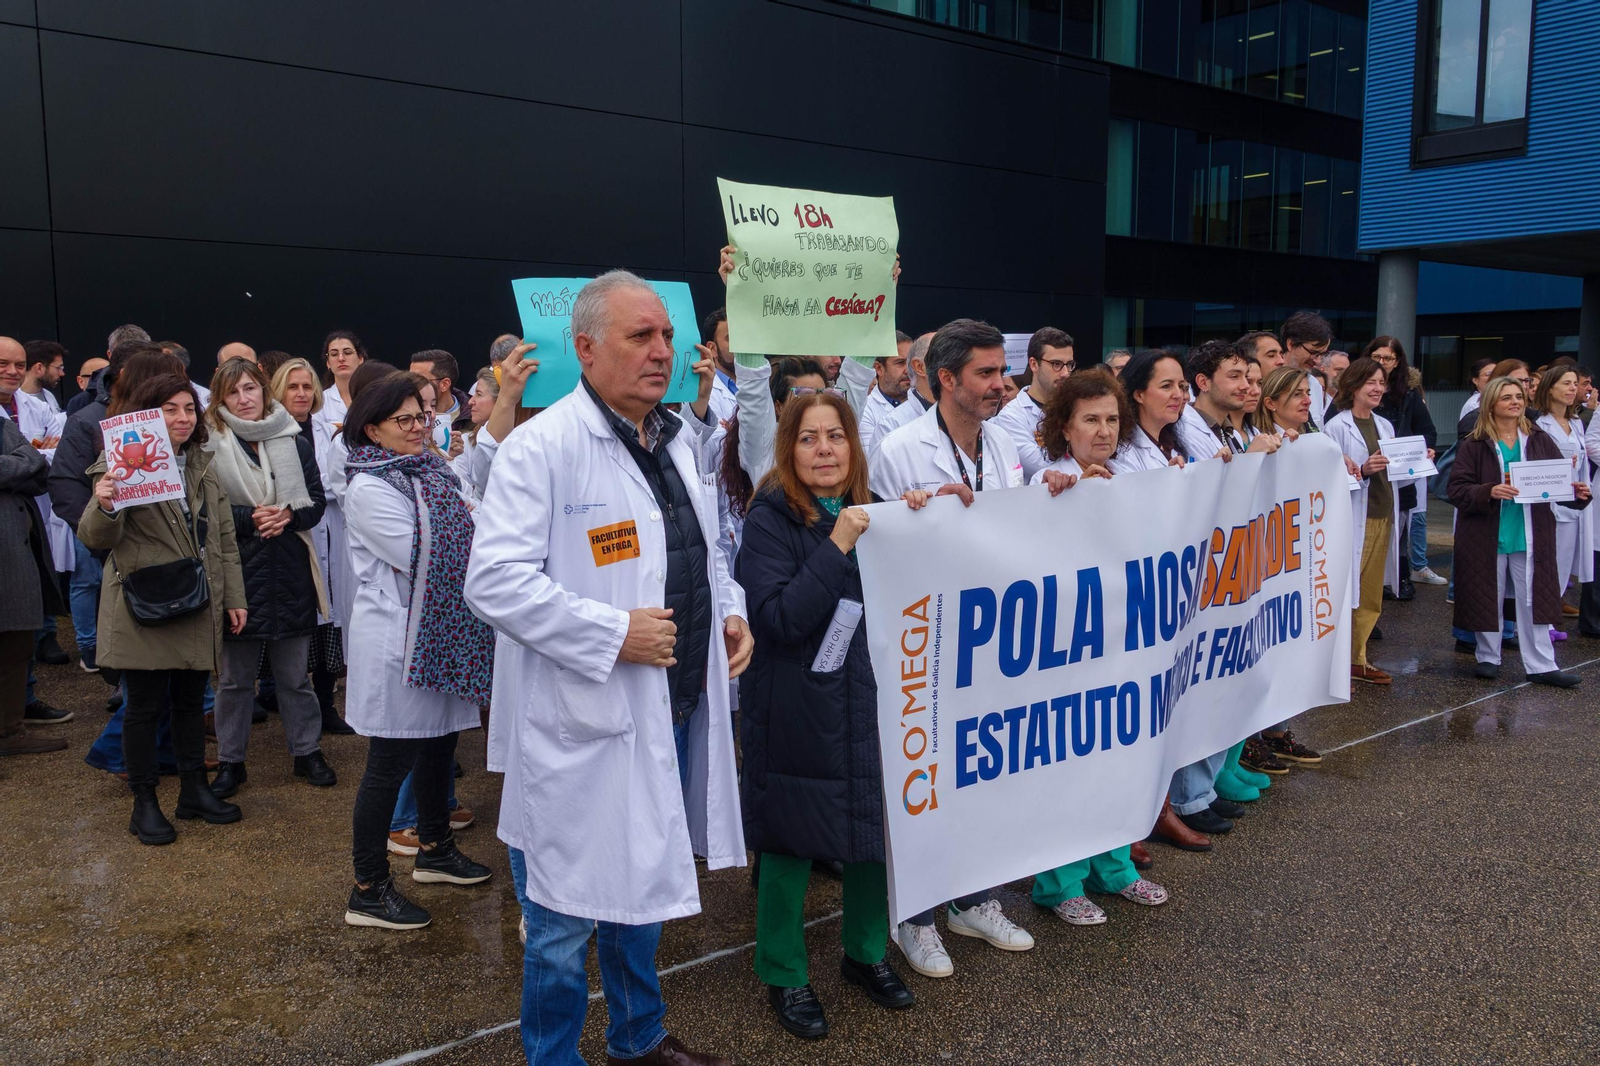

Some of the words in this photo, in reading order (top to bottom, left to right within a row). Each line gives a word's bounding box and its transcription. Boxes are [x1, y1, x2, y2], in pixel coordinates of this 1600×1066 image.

[729, 194, 780, 227] LLEVO
[793, 202, 834, 229] 18h
[794, 231, 889, 254] TRABAJANDO
[812, 262, 838, 282] QUE
[845, 262, 863, 280] TE
[762, 294, 801, 317] HAGA
[803, 297, 822, 317] LA
[825, 292, 886, 322] CESÁREA?
[101, 416, 123, 431] GALICIA
[124, 414, 135, 424] EN
[135, 409, 160, 421] FOLGA
[591, 526, 637, 545] FACULTATIVO
[601, 544, 612, 555] EN
[611, 539, 633, 552] FOLGA
[955, 566, 1104, 690] POLA
[1124, 539, 1208, 653] NOSA
[831, 627, 843, 642] NO
[933, 593, 943, 659] Independentes
[823, 641, 837, 660] HAY
[932, 659, 940, 688] Galicia
[931, 689, 939, 701] de
[955, 681, 1141, 790] ESTATUTO
[1190, 630, 1207, 687] E
